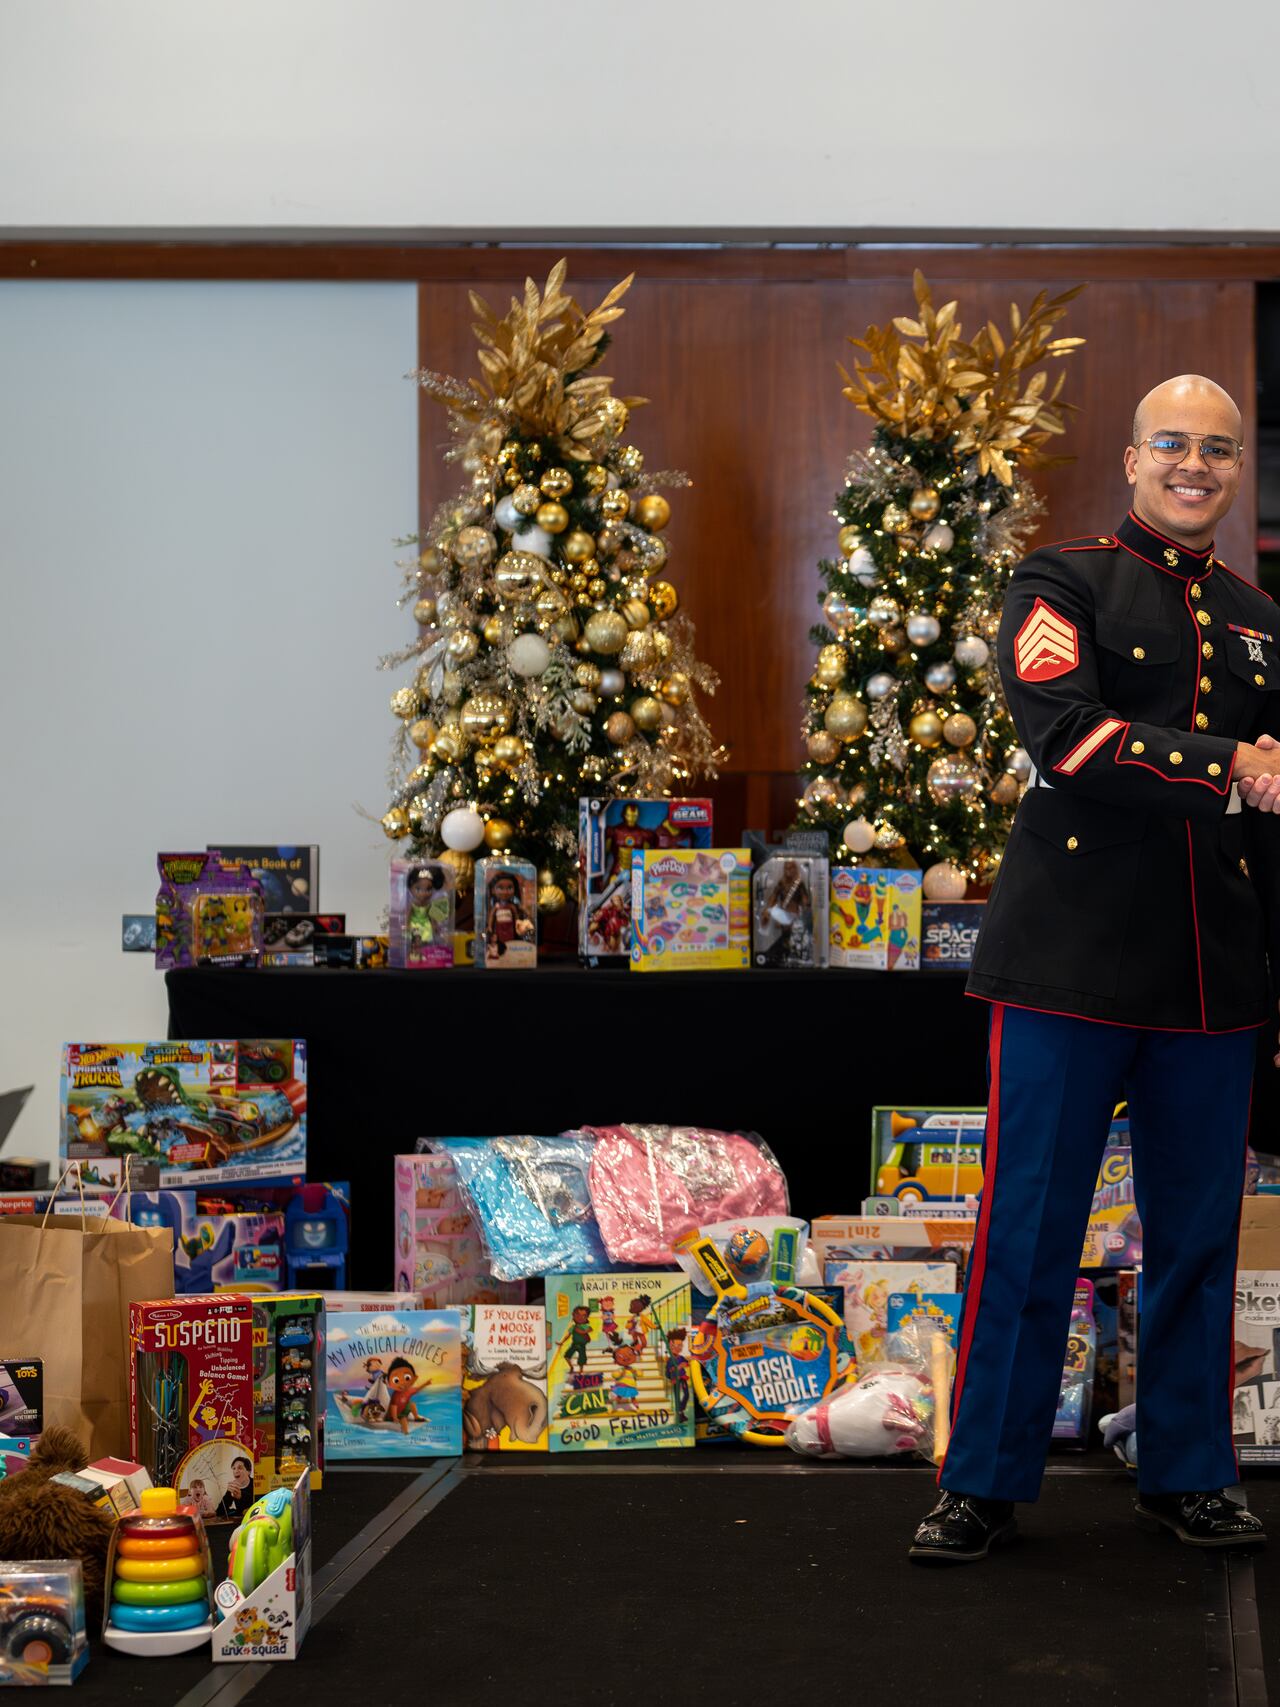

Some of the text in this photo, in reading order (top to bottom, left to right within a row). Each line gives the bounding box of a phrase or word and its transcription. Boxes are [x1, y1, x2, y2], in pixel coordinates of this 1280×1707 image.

[234, 857, 259, 868] First
[261, 857, 287, 869] Book
[290, 857, 302, 869] of
[73, 1071, 123, 1087] TRUCKS
[575, 1282, 609, 1291] TARAJI
[622, 1279, 662, 1290] HENSON
[484, 1309, 542, 1321] IF YOU GIVE
[155, 1317, 241, 1349] SUSPEND
[500, 1323, 535, 1334] MOOSE
[497, 1335, 537, 1346] MUFFIN
[328, 1335, 449, 1367] MY MAGICAL CHOICES
[15, 1369, 38, 1379] TOYS
[211, 1363, 246, 1372] Unbalanced
[727, 1354, 795, 1388] SPLASH
[199, 1369, 250, 1382] Balance Game!
[751, 1374, 822, 1408] PADDLE
[565, 1387, 606, 1415] CAN
[560, 1408, 669, 1445] GOOD FRIEND
[251, 1643, 288, 1657] squad
